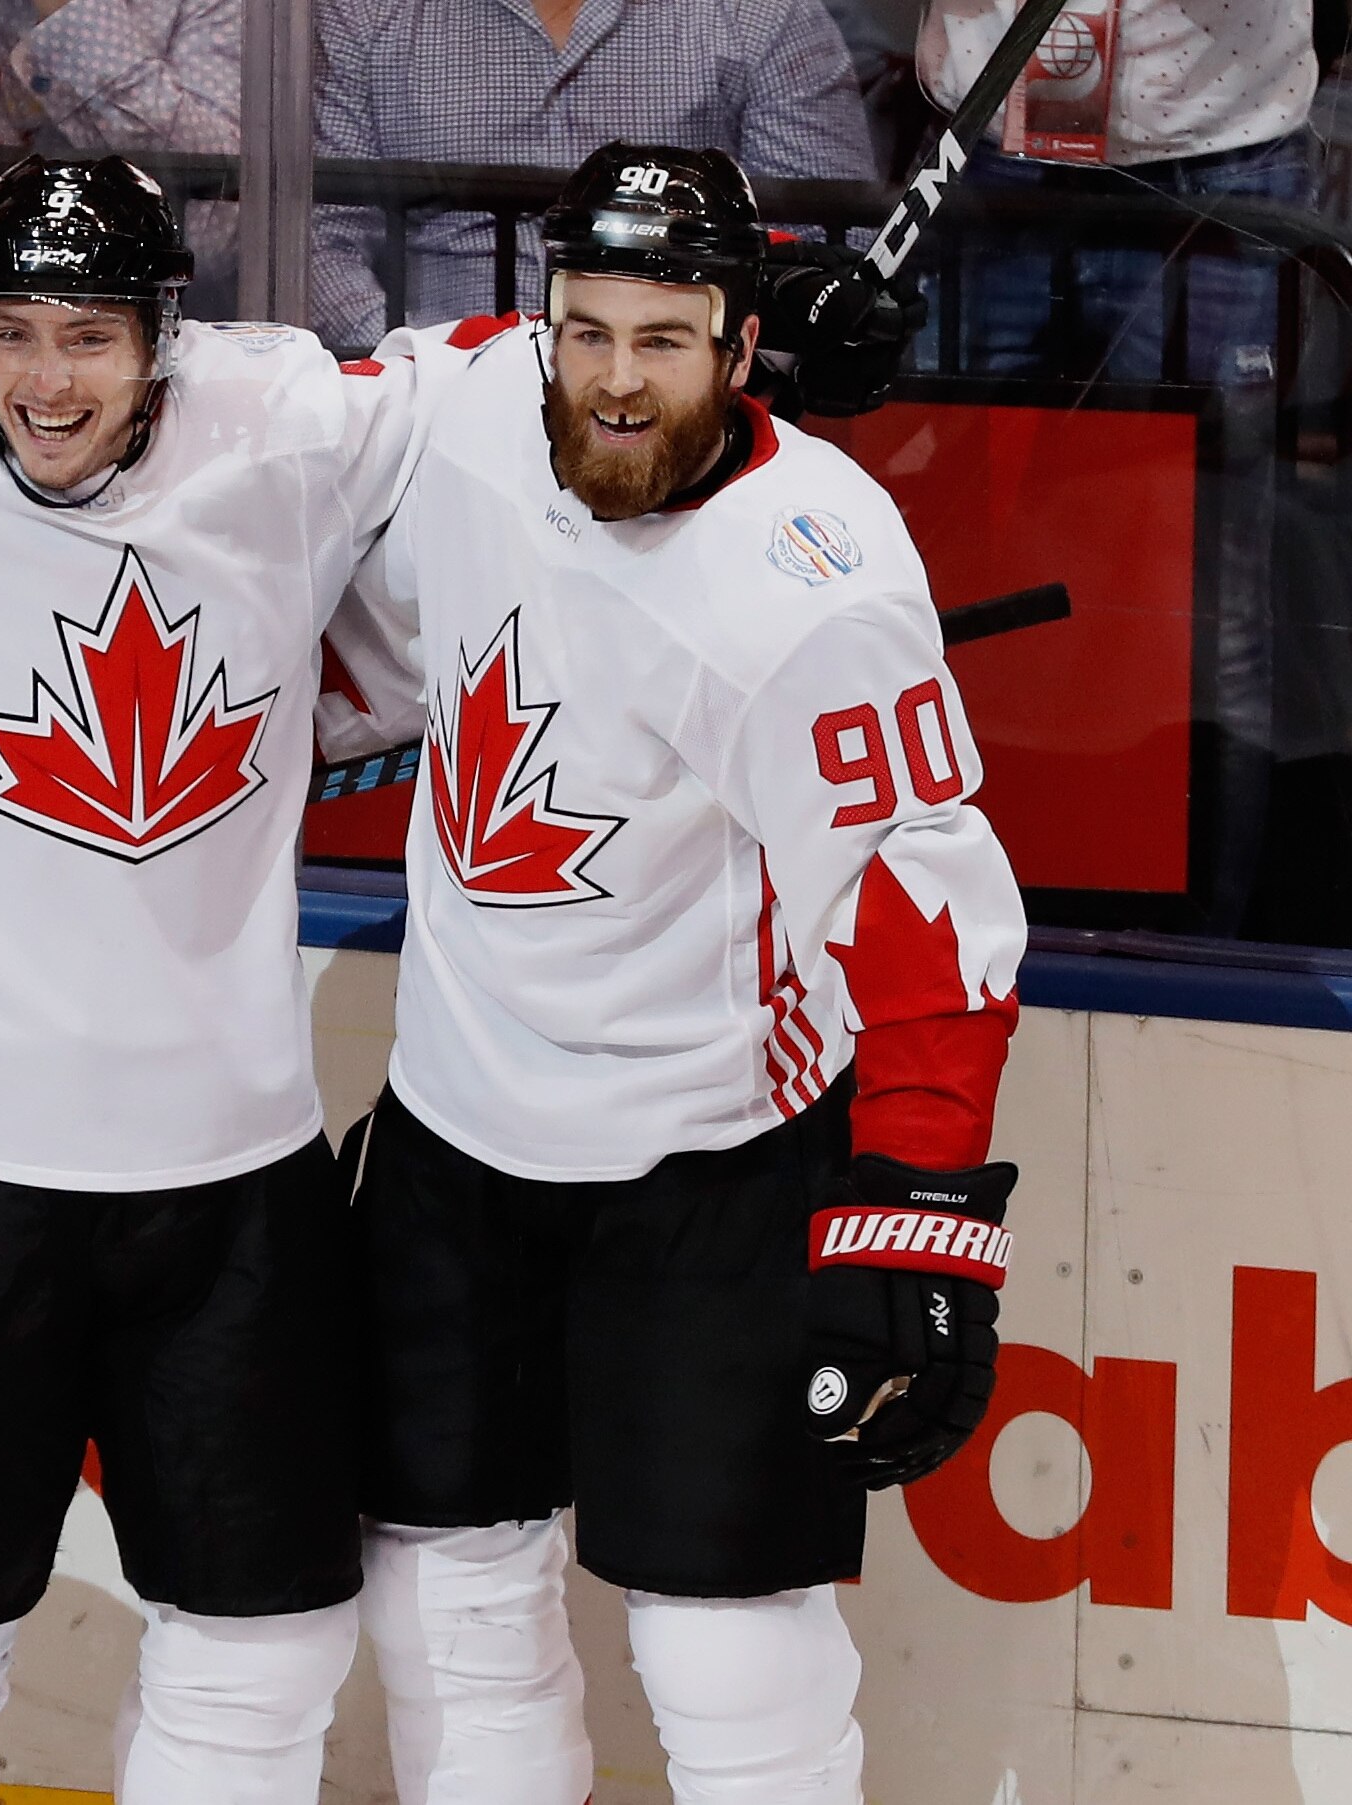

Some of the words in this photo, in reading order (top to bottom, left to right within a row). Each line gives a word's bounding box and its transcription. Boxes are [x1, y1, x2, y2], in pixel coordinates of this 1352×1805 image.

[615, 166, 669, 195] 90
[853, 128, 967, 280] CM
[592, 220, 668, 238] BUER
[545, 503, 582, 543] WCH
[811, 677, 964, 829] 90
[909, 1191, 969, 1204] O'REILLY
